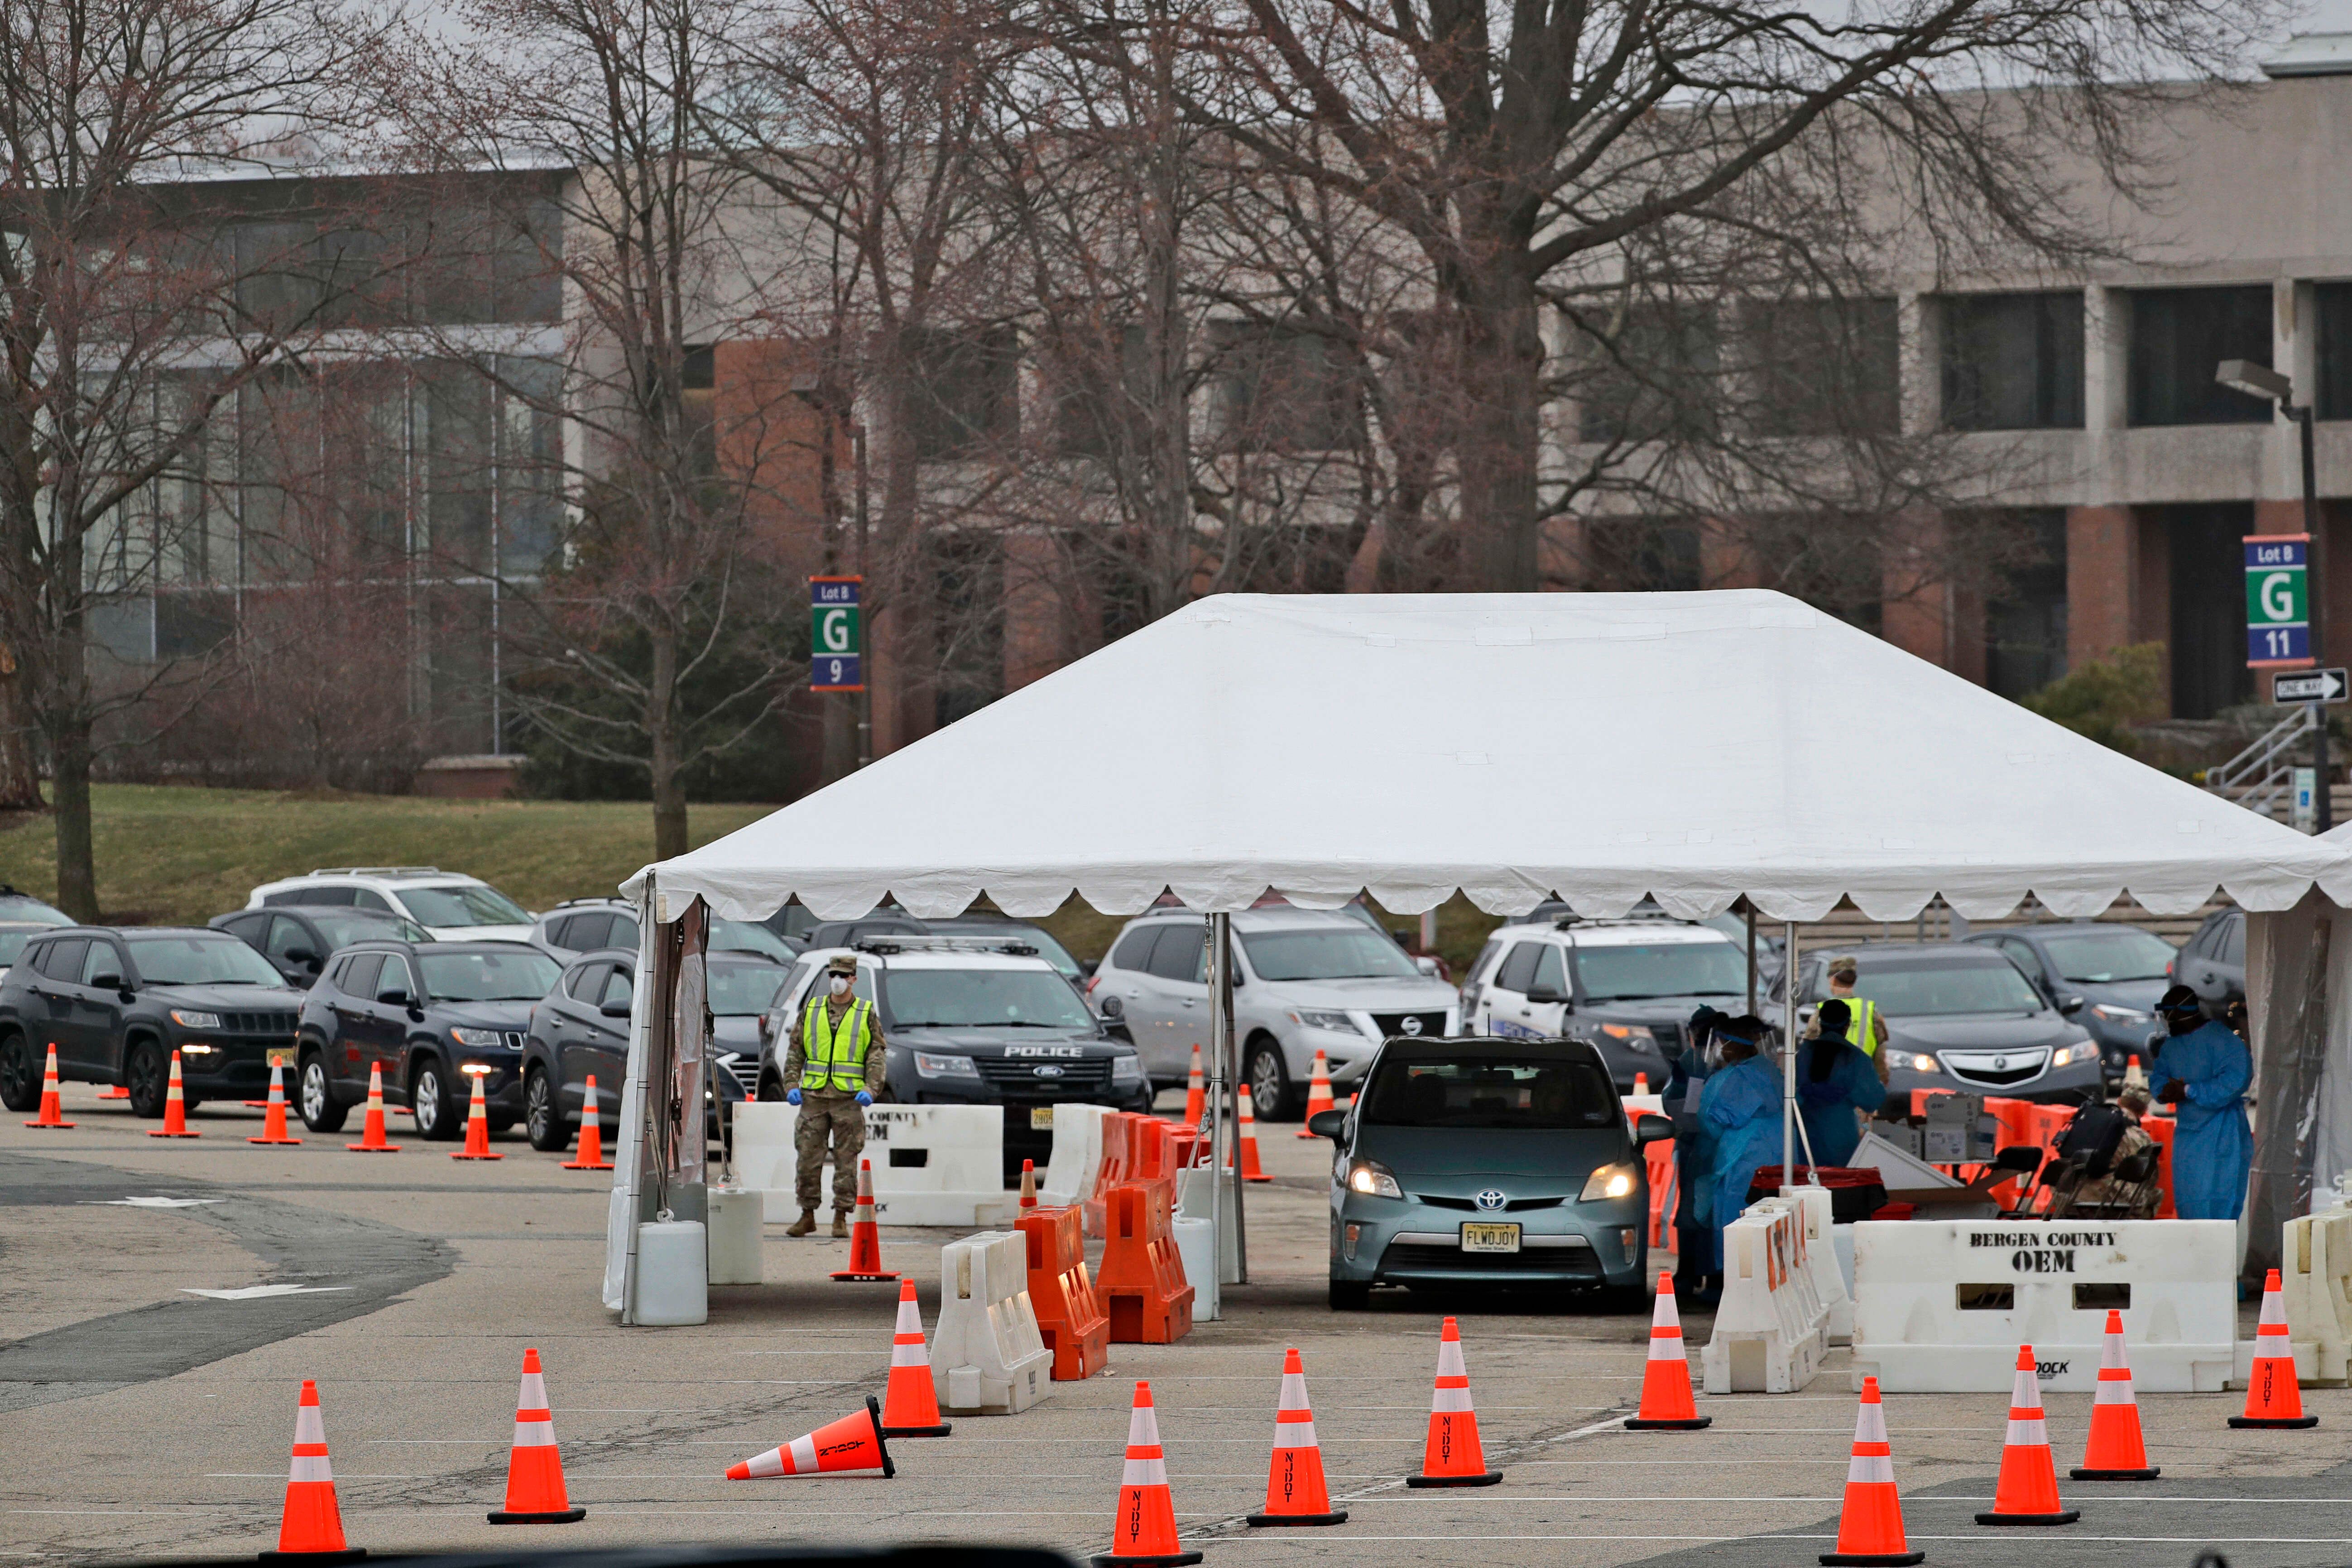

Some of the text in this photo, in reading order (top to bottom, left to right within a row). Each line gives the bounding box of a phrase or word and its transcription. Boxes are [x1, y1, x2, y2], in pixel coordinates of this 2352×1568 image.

[2258, 545, 2293, 562] Lot B
[821, 585, 839, 600] Lot
[2261, 572, 2294, 621] G
[823, 609, 848, 651] G
[2266, 629, 2290, 657] 11
[830, 659, 842, 683] 9
[2280, 680, 2323, 693] ONE WAY
[1003, 1046, 1083, 1058] POLICE
[869, 1112, 917, 1122] COUNTY
[1970, 1232, 2117, 1247] BERGEN COUNTY
[2012, 1250, 2075, 1272] OEM
[2263, 1362, 2273, 1408] NJDOT
[819, 1440, 865, 1457] NJDOT
[1442, 1416, 1450, 1464] NJDOT
[1285, 1452, 1293, 1503] NJDOT
[1131, 1490, 1141, 1544] NJDOT
